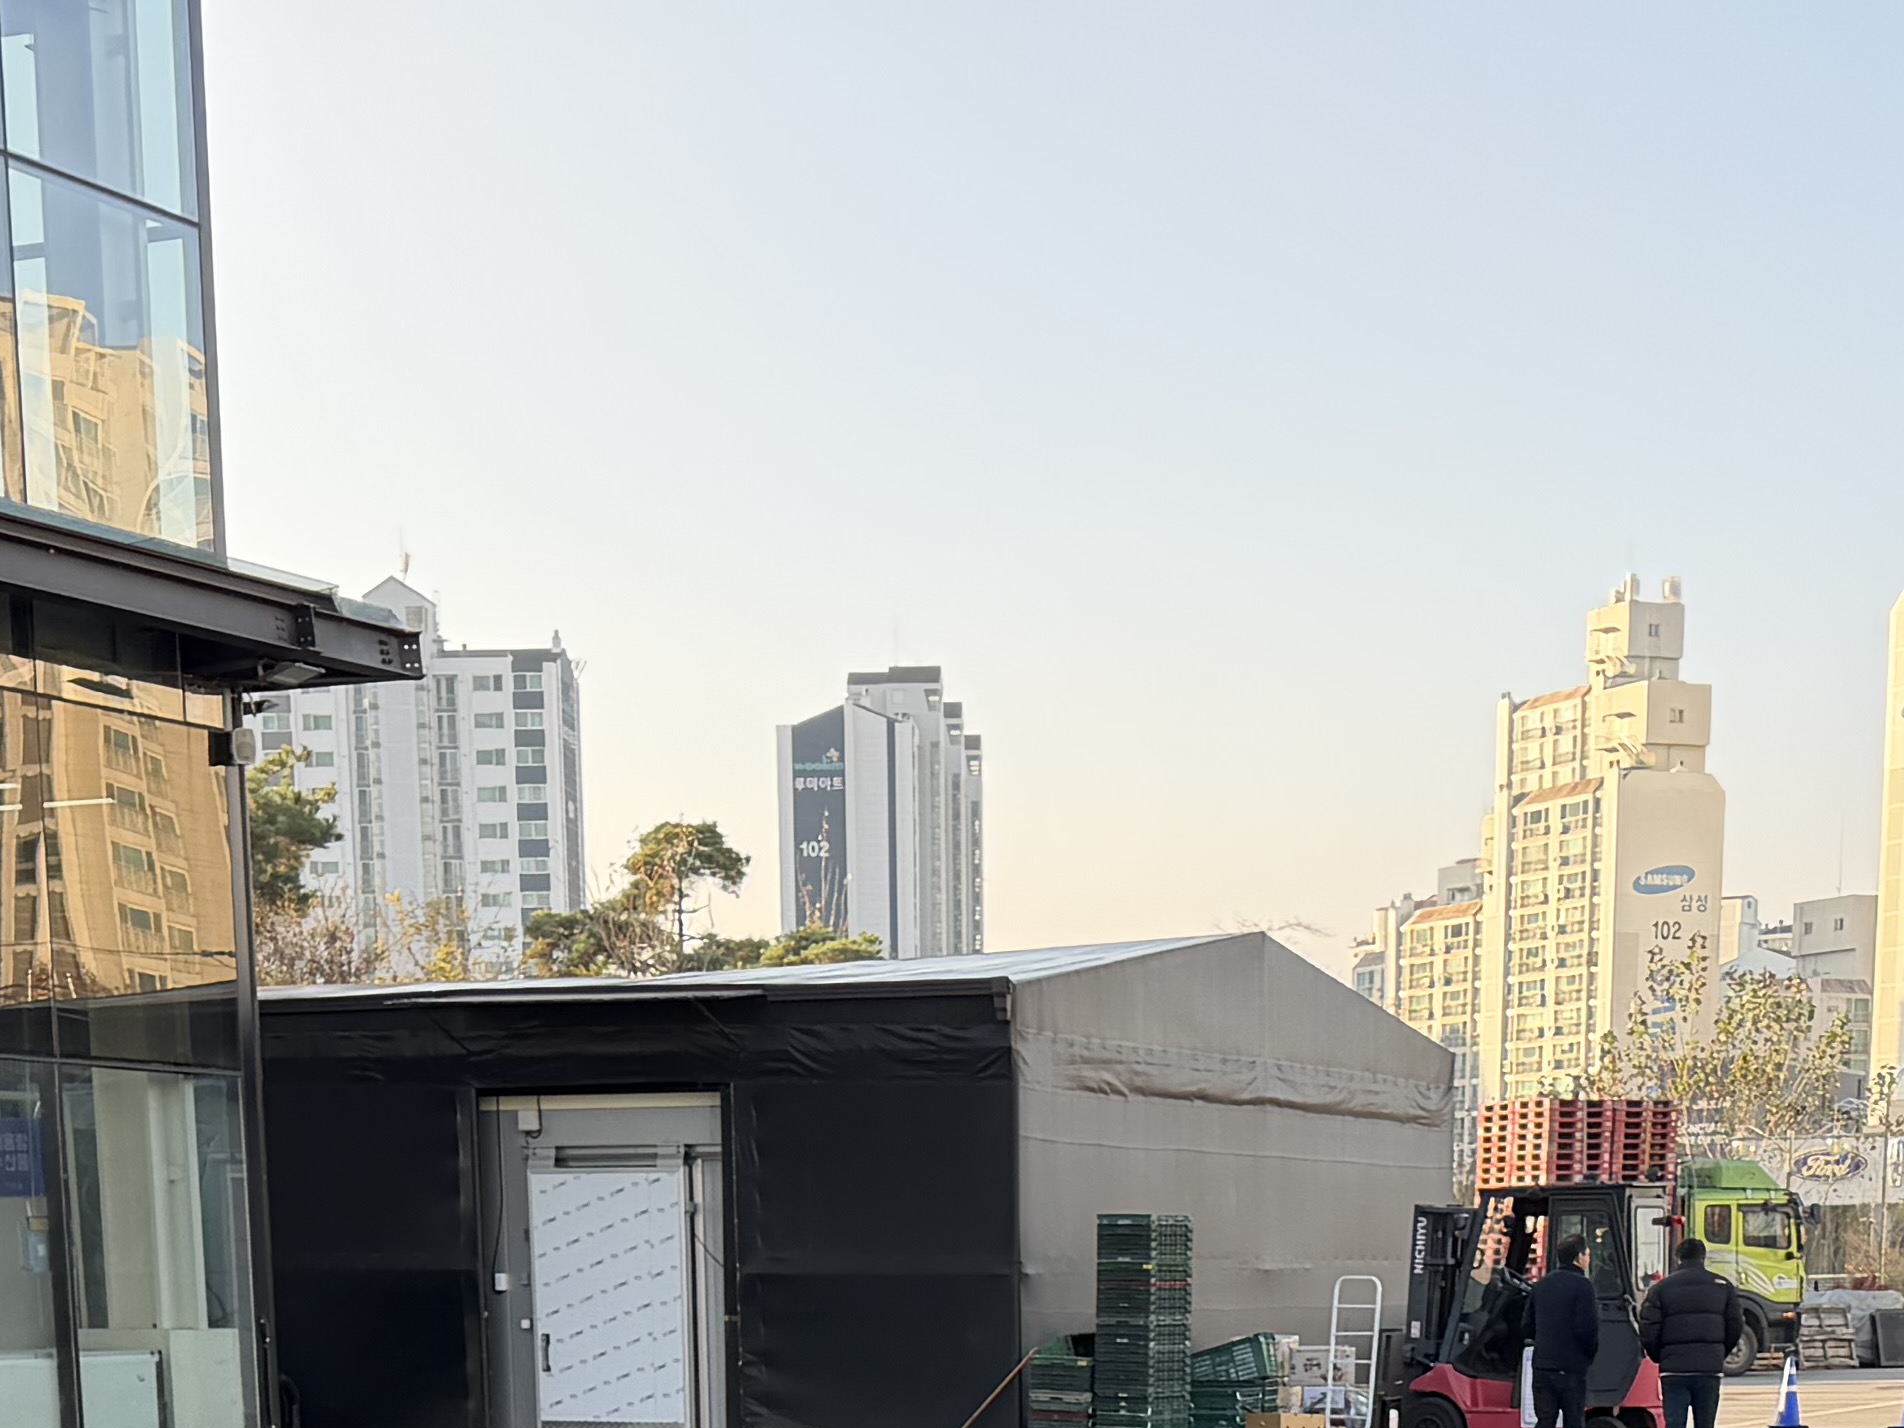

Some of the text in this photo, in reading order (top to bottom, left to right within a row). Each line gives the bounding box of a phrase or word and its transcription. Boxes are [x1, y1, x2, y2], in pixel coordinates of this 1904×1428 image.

[800, 841, 830, 857] 102
[1638, 872, 1689, 887] SAMSUNG
[1680, 894, 1708, 913] 삼성
[1652, 920, 1682, 940] 102
[1414, 1216, 1428, 1274] NICHIYU
